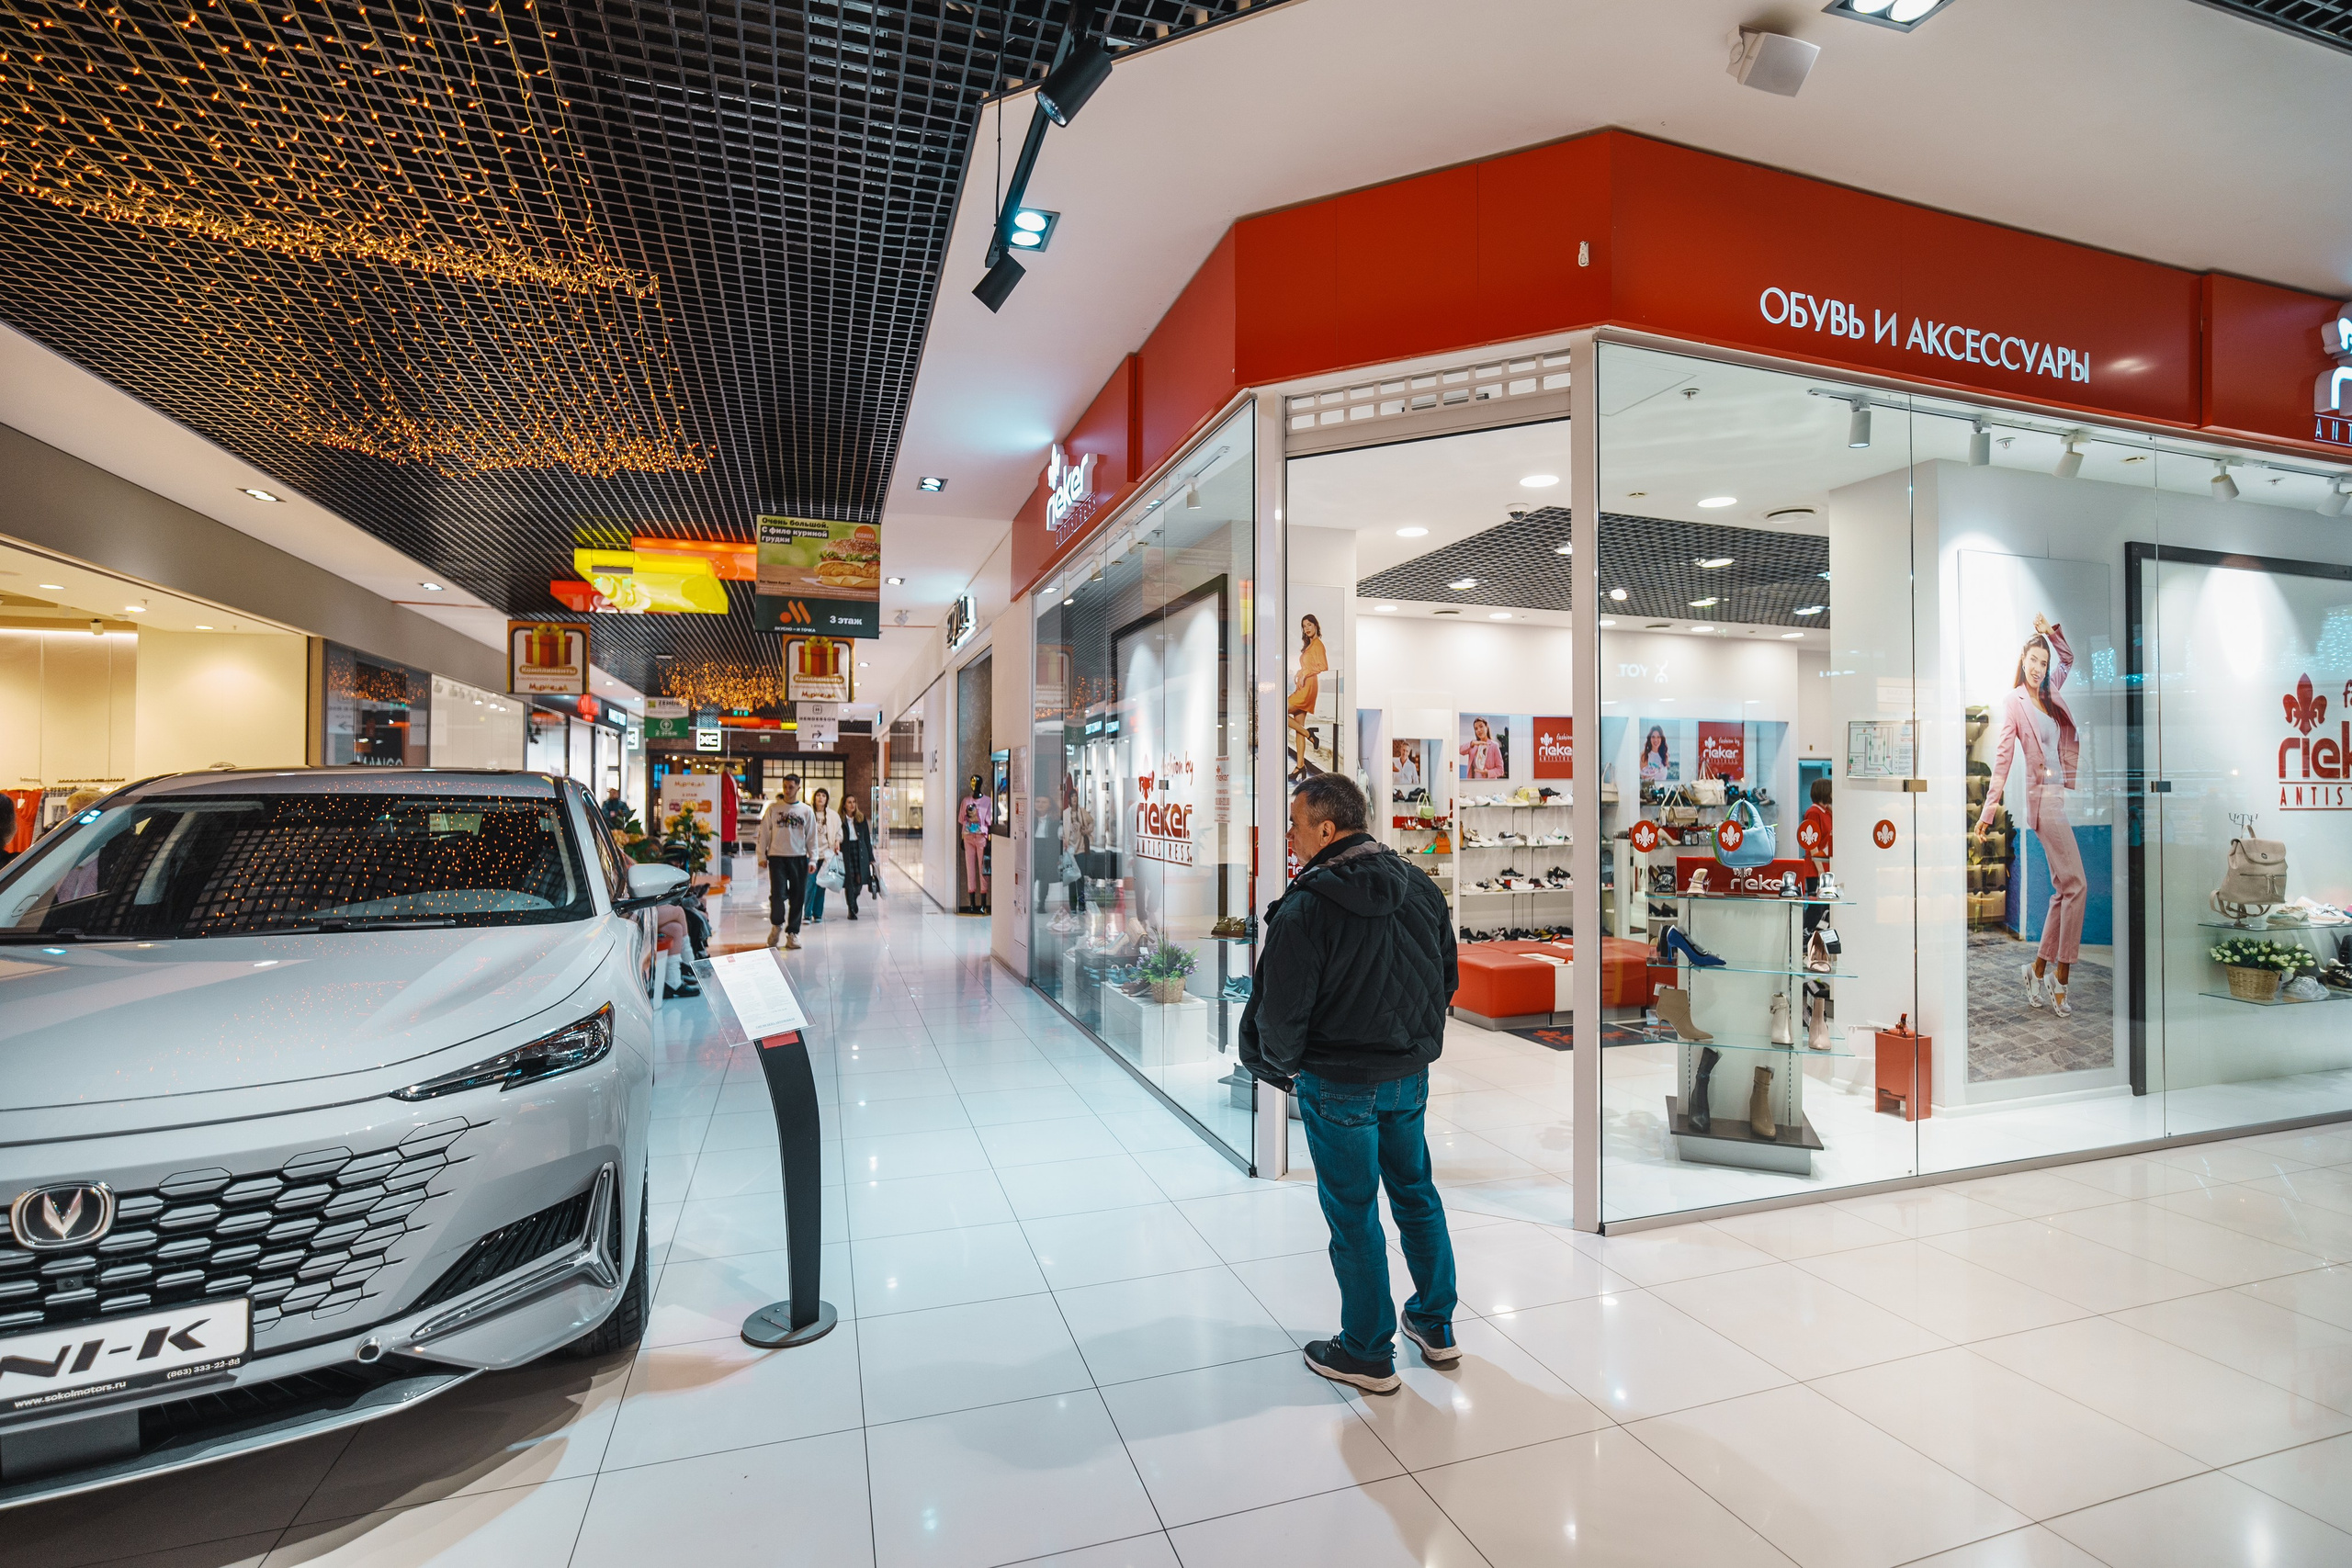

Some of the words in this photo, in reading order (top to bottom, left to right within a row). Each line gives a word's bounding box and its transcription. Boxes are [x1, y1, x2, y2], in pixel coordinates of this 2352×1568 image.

[1759, 287, 1865, 339] ОБУВЬ
[1874, 309, 1897, 346] И
[1905, 317, 2089, 383] АКСЕССУАРЫ
[762, 517, 788, 526] Очень
[790, 520, 830, 529] большой.
[769, 526, 791, 536] филе
[793, 529, 828, 537] куриной
[761, 536, 790, 544] грудки
[830, 615, 837, 624] 3
[838, 616, 863, 626] этаж
[521, 666, 576, 675] Комплименты
[795, 675, 842, 684] Комплименты
[1539, 742, 1572, 756] rieke
[1702, 745, 1739, 759] rieker
[1184, 750, 1193, 786] by
[2279, 786, 2352, 807] ANTIS
[1136, 801, 1193, 840] rieker
[1136, 839, 1193, 863] ANTISRESS
[1730, 874, 1784, 891] reke
[166, 1368, 192, 1380] (863)
[14, 1381, 127, 1409] www.sokolmotors.ru
